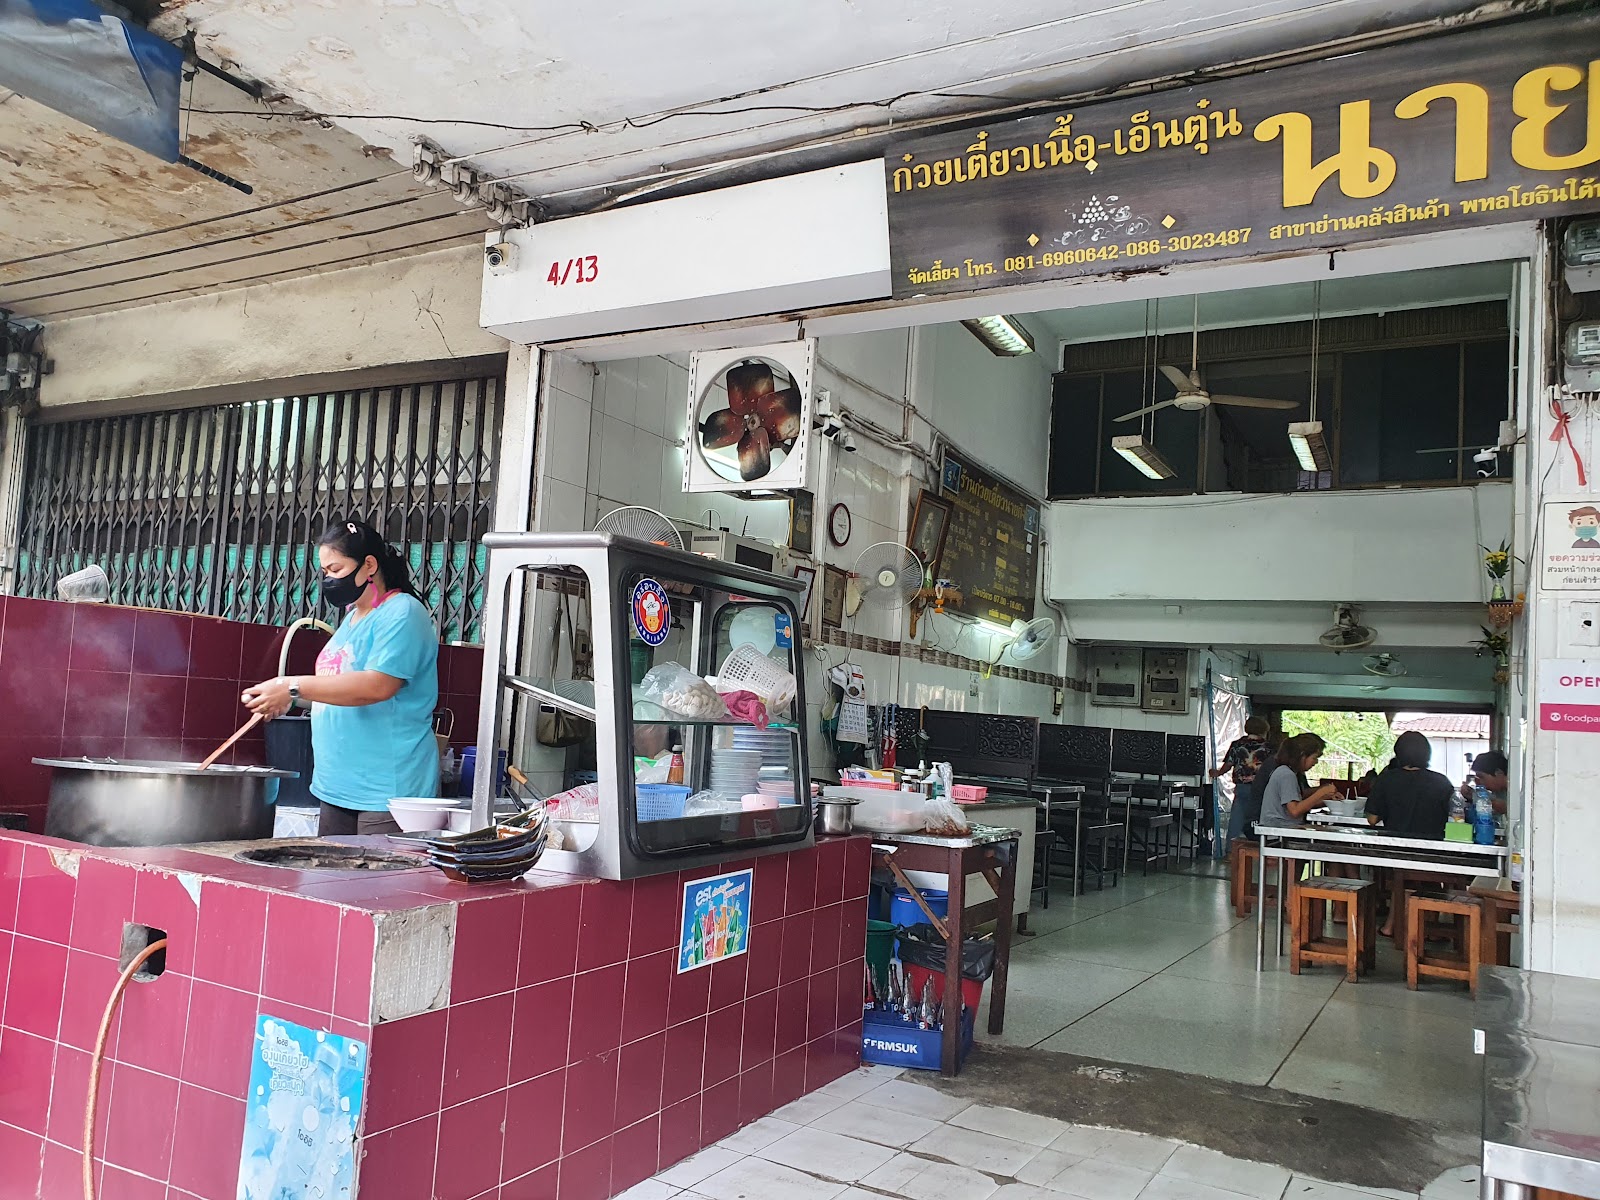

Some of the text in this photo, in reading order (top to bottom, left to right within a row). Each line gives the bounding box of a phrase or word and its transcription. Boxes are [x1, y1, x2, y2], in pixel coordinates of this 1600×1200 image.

[892, 98, 1243, 193] ก๋วยเตี๋ยวเนื้อ-เอ็นตุ๋น
[1253, 60, 1600, 208] นาย
[1269, 198, 1450, 240] สาขาย่านคลังสินค้า
[547, 255, 598, 286] 4/13
[907, 227, 1252, 285] จัดเลี้ยง โทร. 081-6960642-086-3023487
